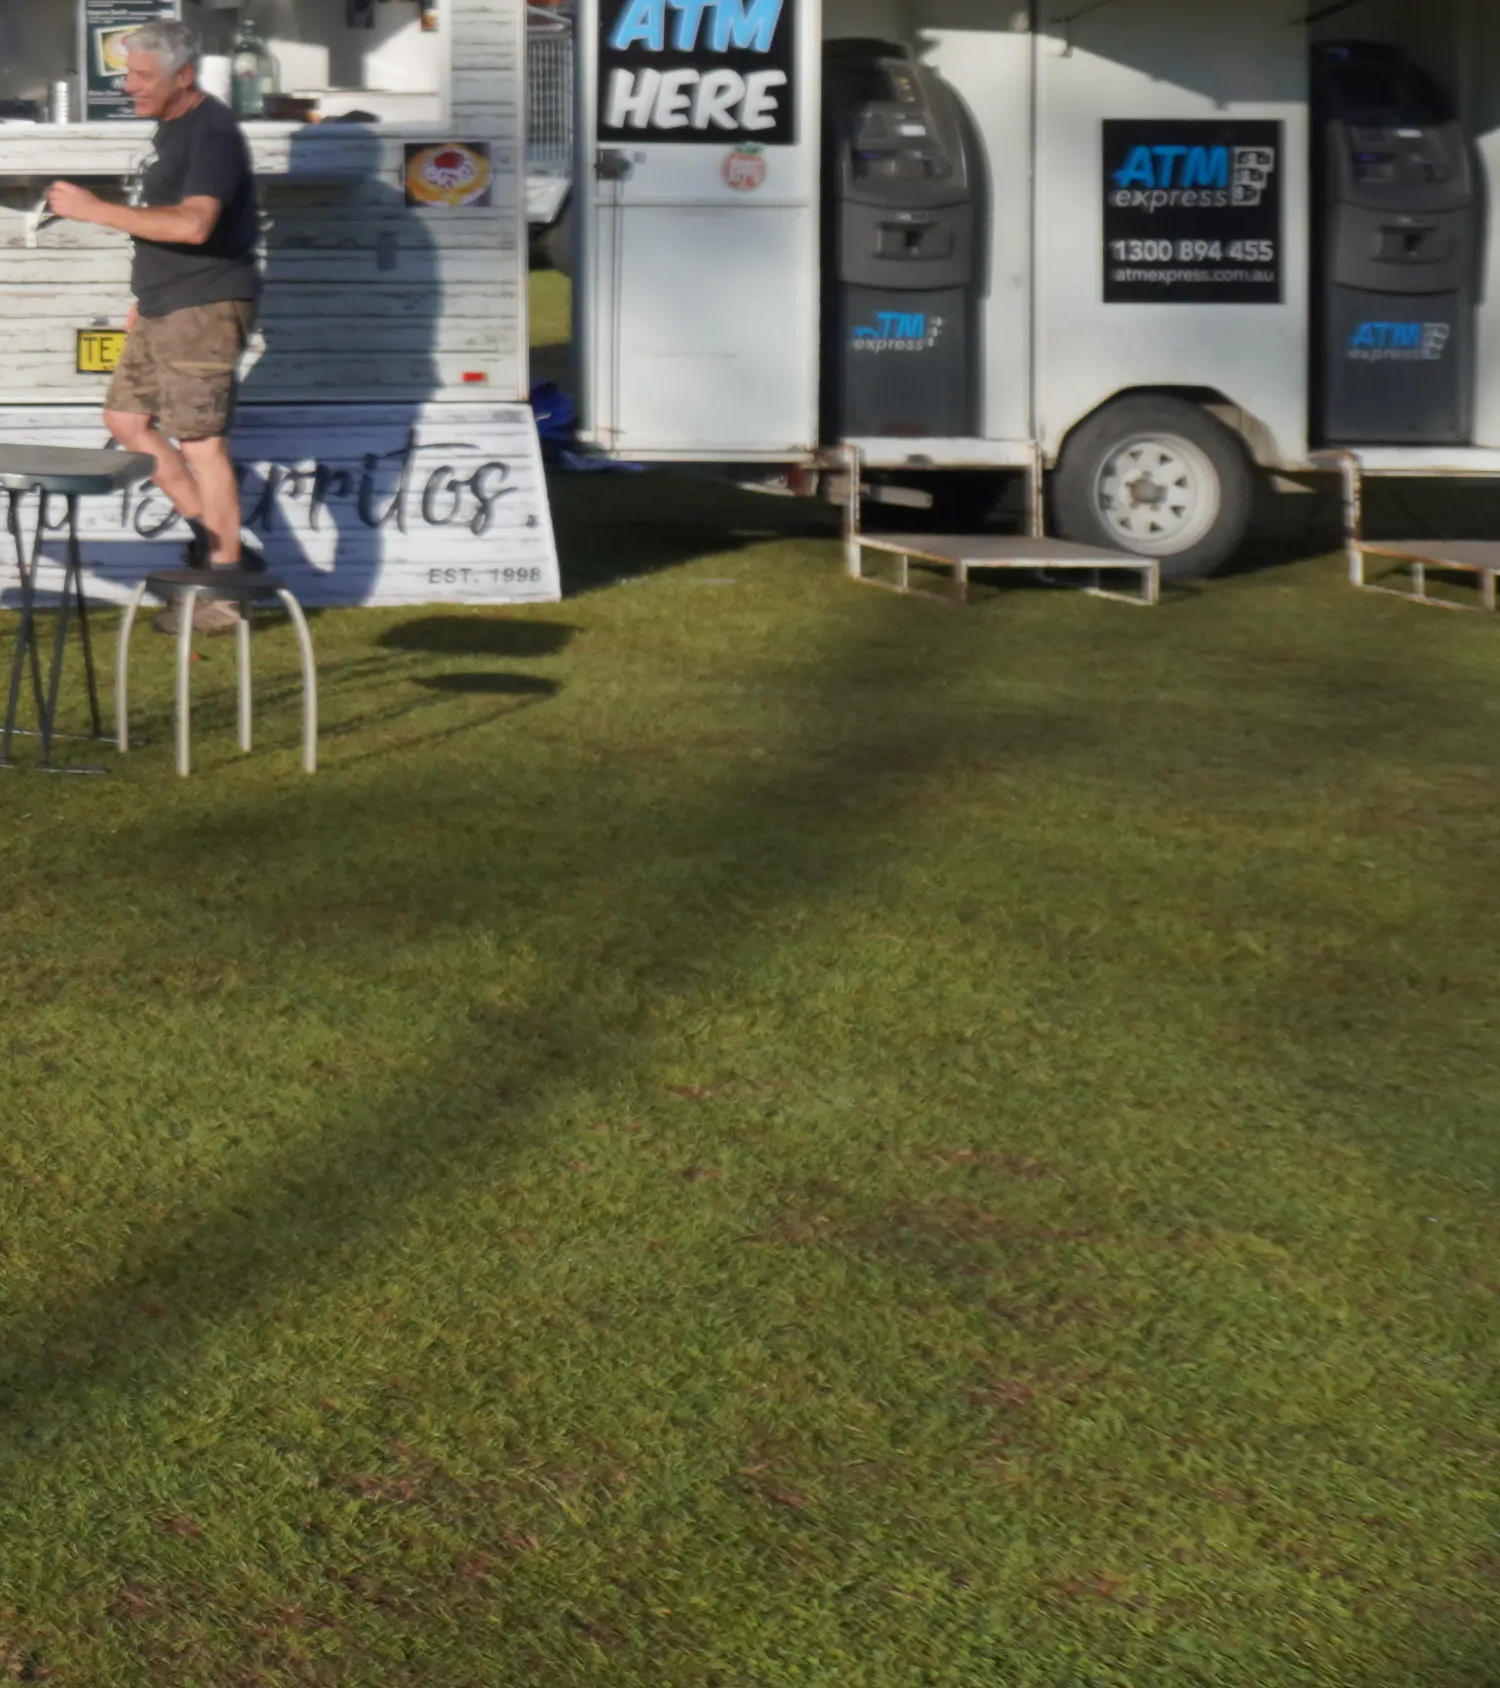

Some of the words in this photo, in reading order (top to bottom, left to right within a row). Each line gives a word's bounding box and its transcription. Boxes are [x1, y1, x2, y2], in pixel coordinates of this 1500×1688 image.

[604, 67, 787, 131] HERE
[1111, 144, 1229, 189] ATM
[1110, 188, 1229, 214] express
[1112, 238, 1173, 262] 1300
[1177, 238, 1222, 262] 894
[1228, 238, 1275, 262] 455
[1112, 267, 1275, 286] atmexpress.com.au
[854, 339, 924, 354] express
[1350, 322, 1421, 347] ATM
[428, 568, 479, 585] EST.
[493, 567, 542, 585] 1998
